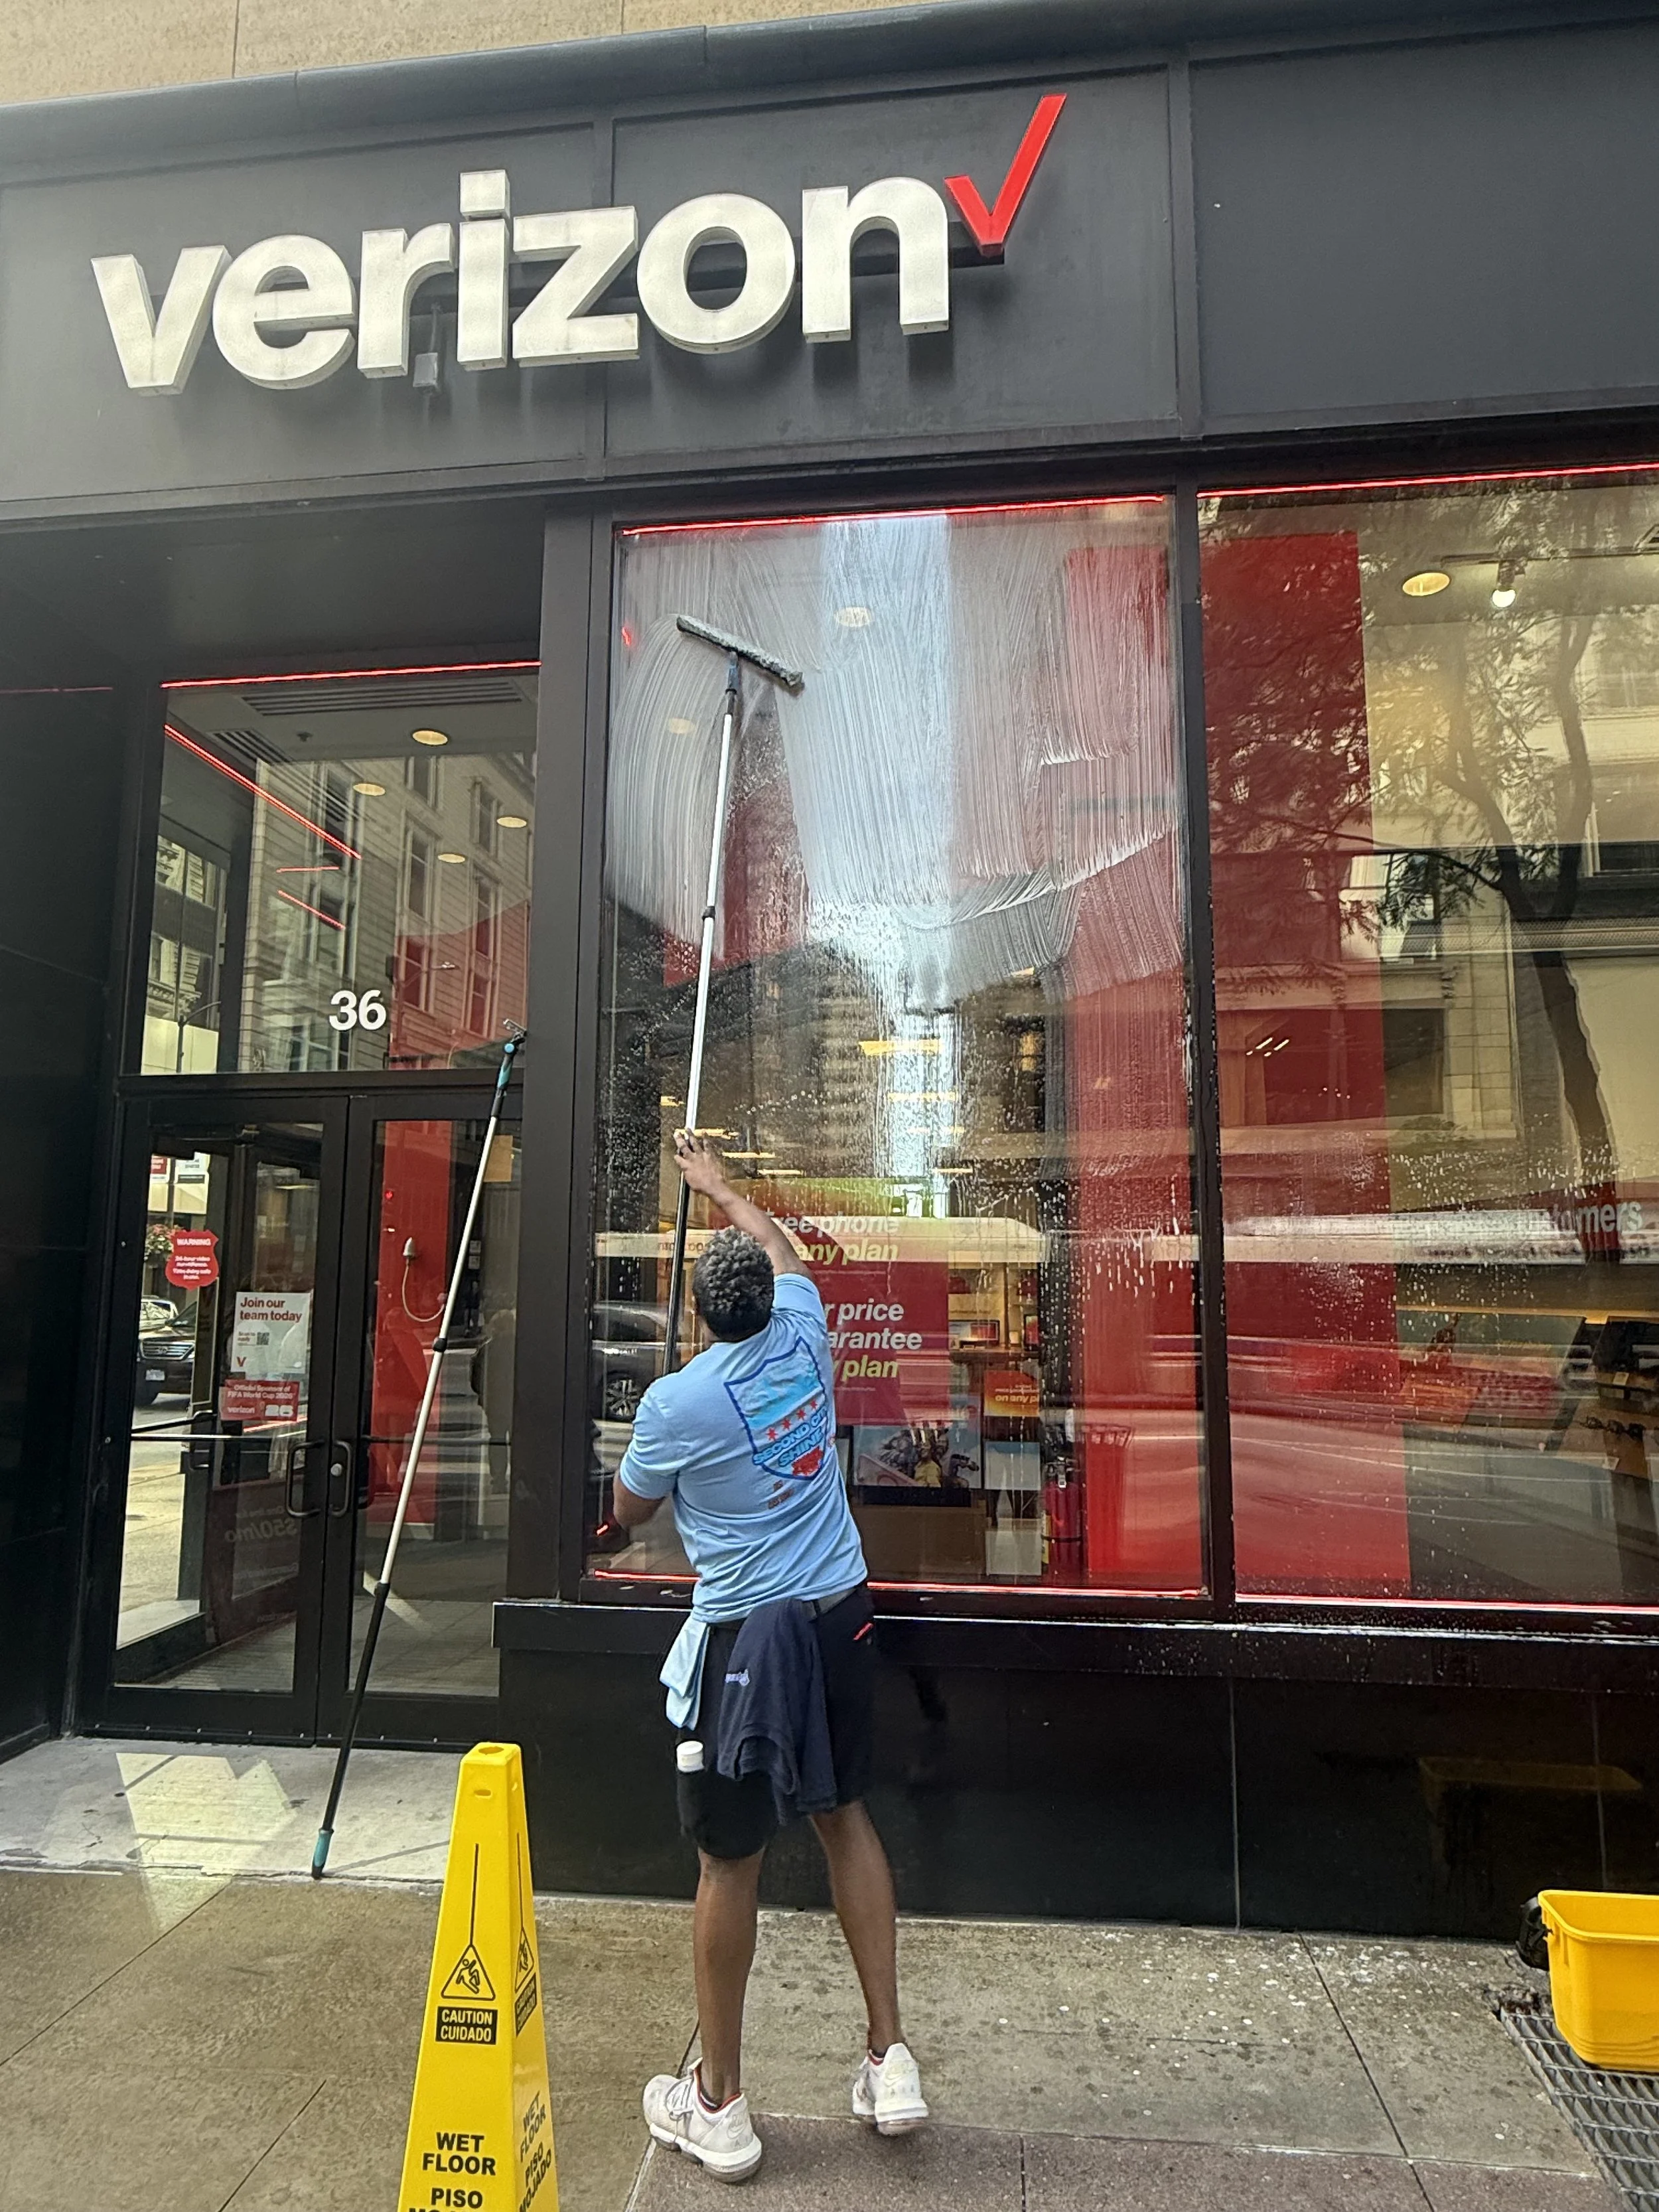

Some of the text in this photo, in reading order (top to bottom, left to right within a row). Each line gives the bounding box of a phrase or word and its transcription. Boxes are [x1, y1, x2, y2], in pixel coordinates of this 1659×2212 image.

[91, 169, 950, 395] verizon
[329, 990, 386, 1031] 36
[817, 1209, 899, 1238] phone
[796, 1239, 899, 1266] any plan
[240, 1297, 264, 1308] Join
[837, 1298, 904, 1325] price
[240, 1310, 303, 1323] team today
[828, 1327, 923, 1350] arantee
[841, 1355, 899, 1383] plan
[228, 1406, 255, 1414] verizon
[1010, 1395, 1029, 1404] any
[753, 1423, 810, 1465] SECOND
[778, 1427, 824, 1467] SHINE
[441, 2009, 493, 2026] CAUTION
[440, 2025, 492, 2042] CUIDADO
[523, 2091, 540, 2132] WET
[436, 2132, 485, 2153] WET
[520, 2104, 545, 2163] FLOOR
[423, 2152, 496, 2176] FLOOR
[525, 2142, 543, 2188] PISO
[431, 2187, 483, 2209] PISO
